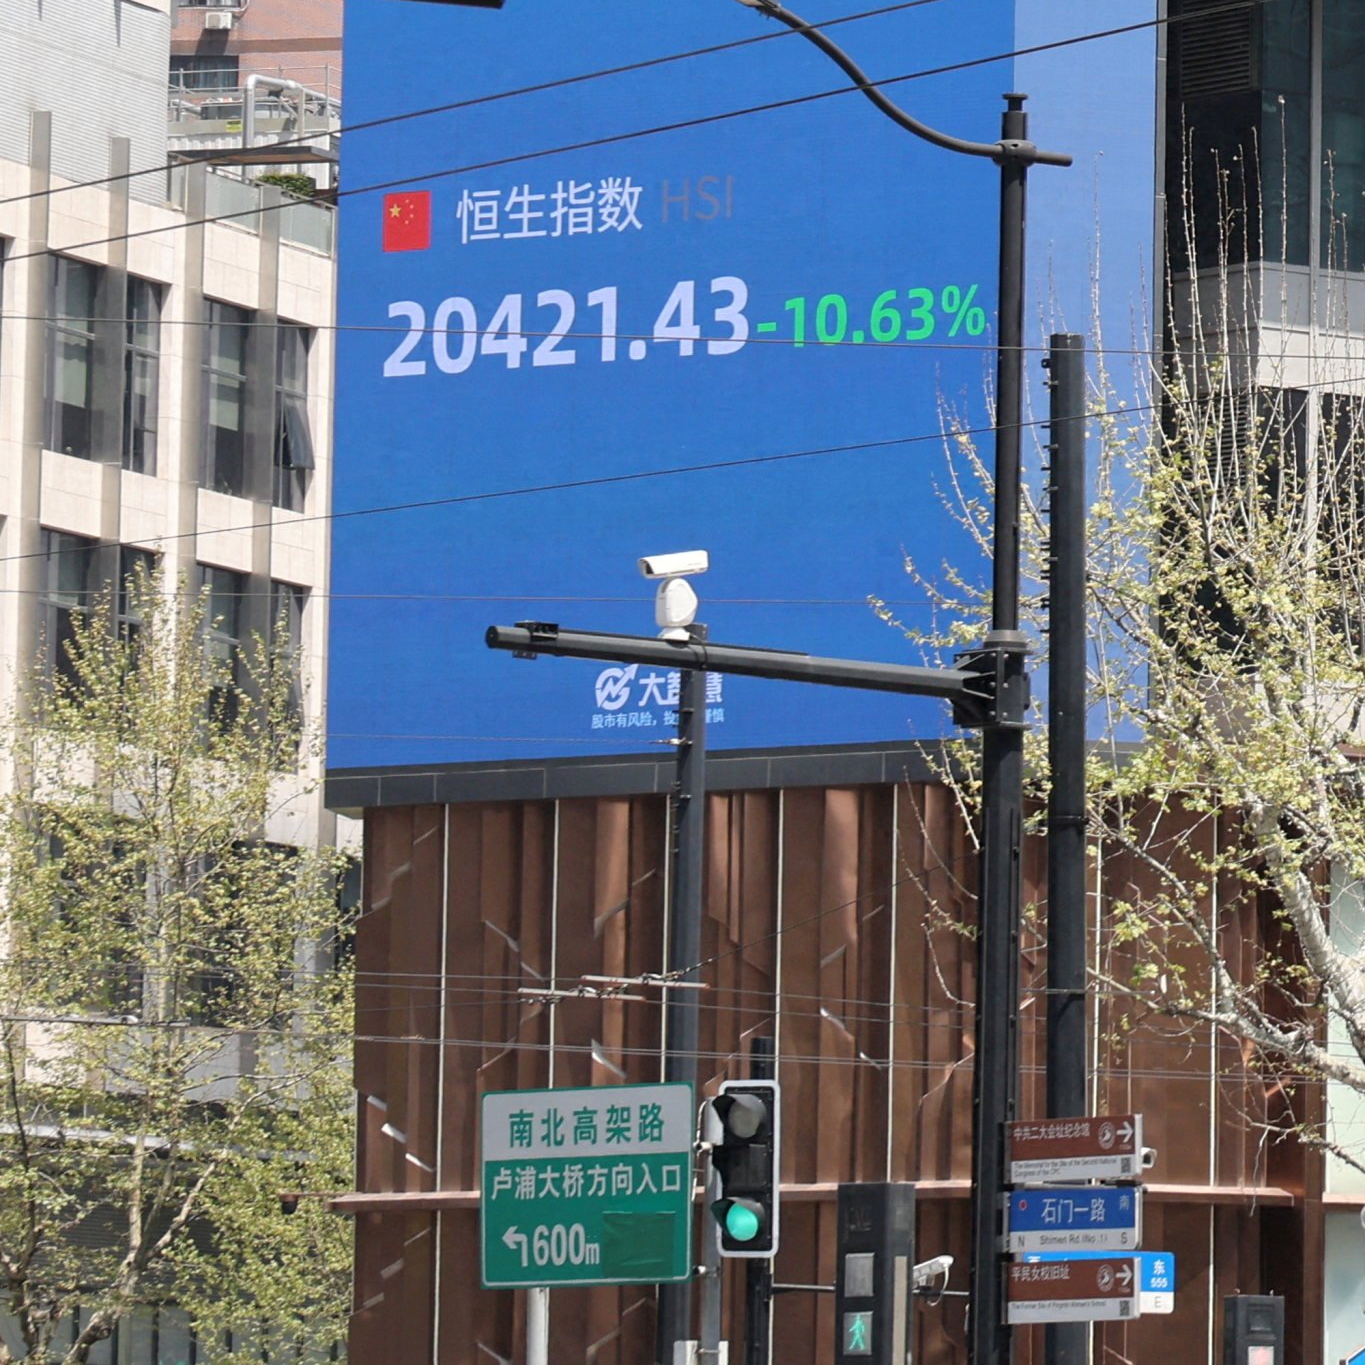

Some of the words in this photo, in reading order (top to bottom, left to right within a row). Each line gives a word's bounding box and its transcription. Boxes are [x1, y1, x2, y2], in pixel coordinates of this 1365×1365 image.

[456, 177, 643, 245] 恒生指数
[661, 175, 735, 223] HSI
[383, 276, 750, 378] 20421.43
[756, 283, 986, 348] -10.63%
[509, 1103, 665, 1148] 南北高架路
[491, 1163, 682, 1200] 卢浦大桥方向入口
[1041, 1198, 1106, 1223] 石门一路
[532, 1222, 600, 1266] 600m
